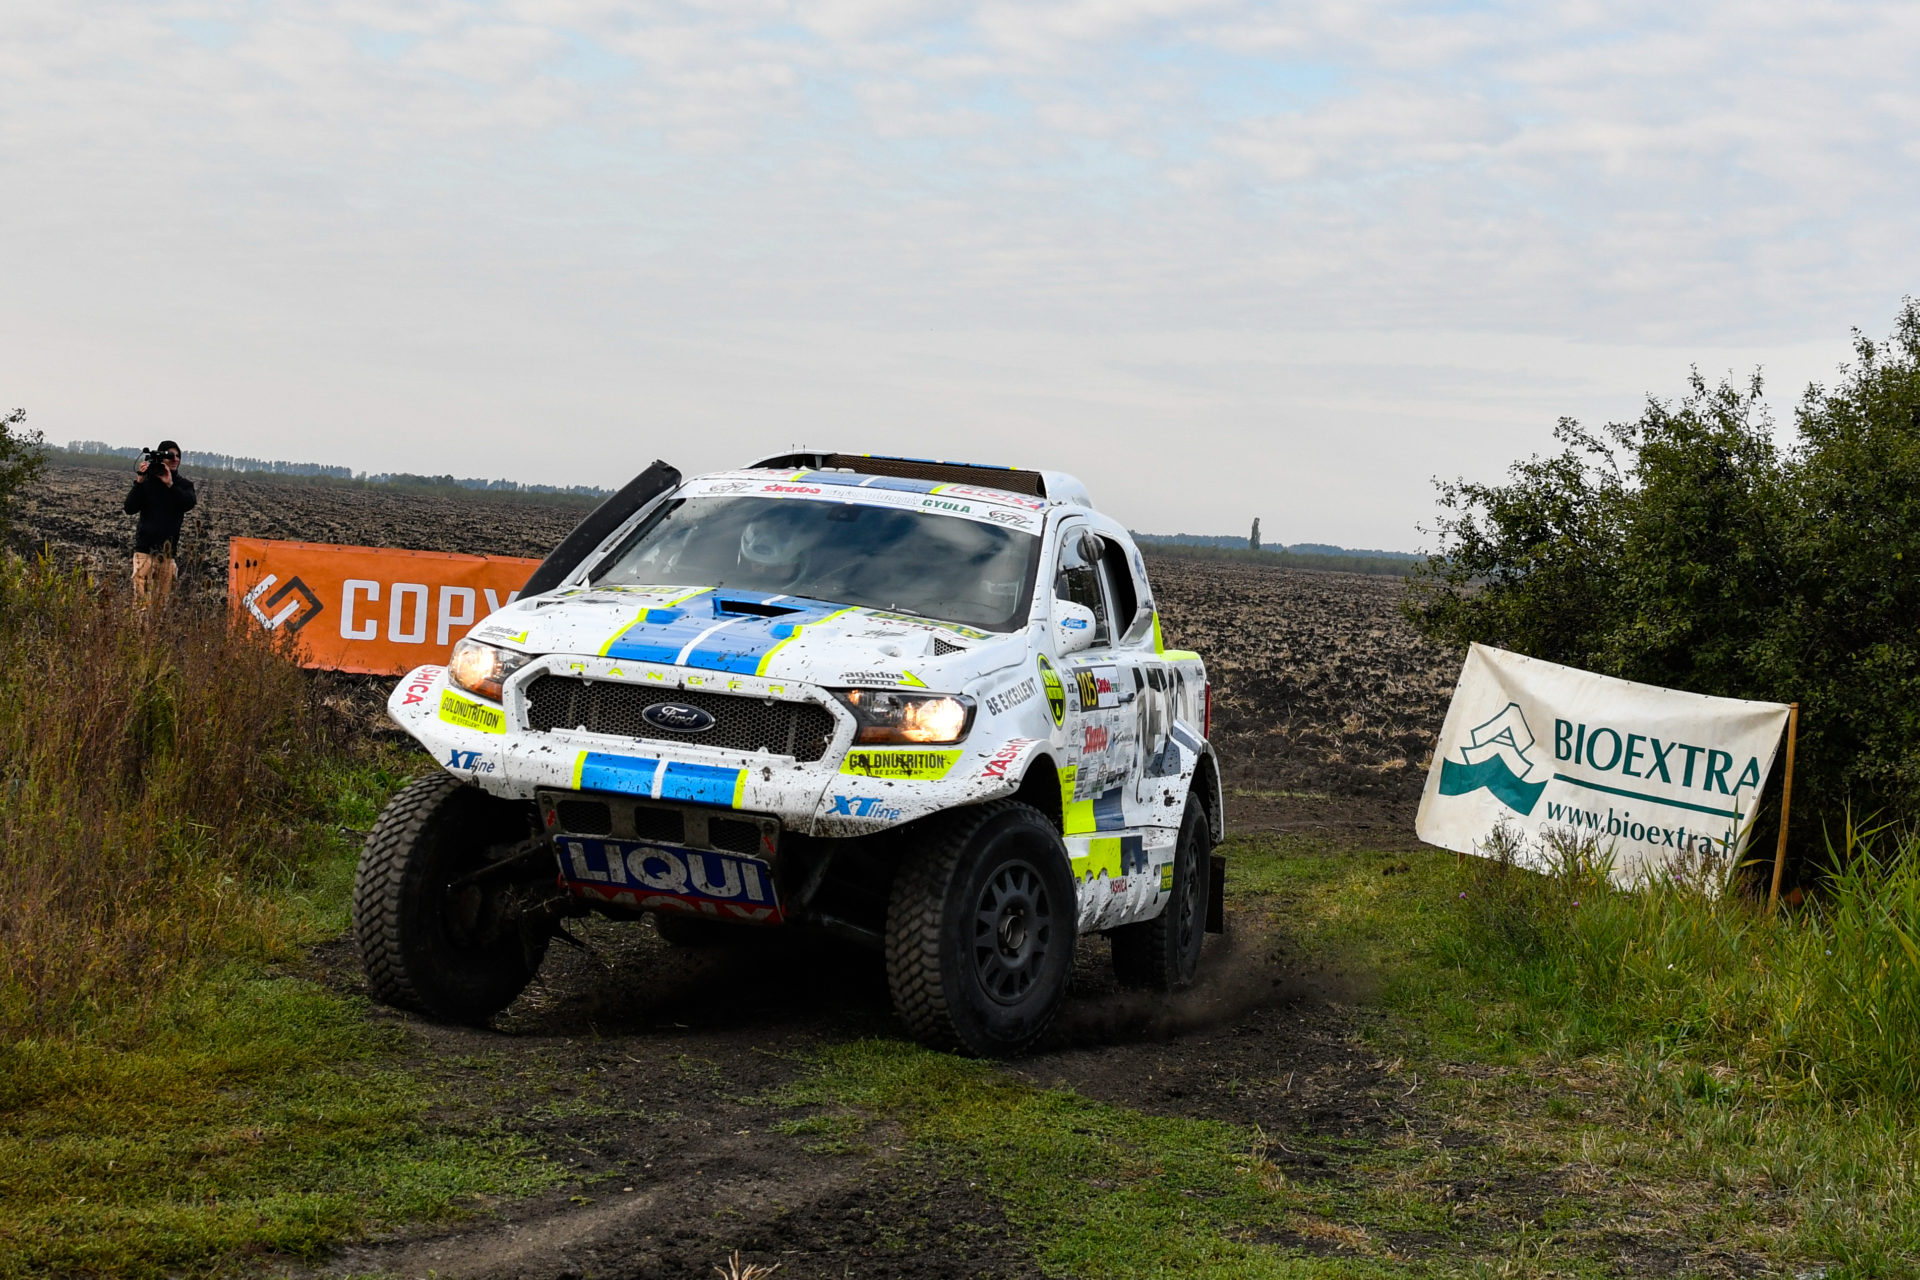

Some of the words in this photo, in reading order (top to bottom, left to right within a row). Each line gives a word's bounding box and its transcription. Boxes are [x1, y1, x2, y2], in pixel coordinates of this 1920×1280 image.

[922, 499, 971, 514] GYULA
[570, 663, 784, 694] RANGER
[845, 670, 904, 680] agados
[1076, 671, 1097, 707] 105
[985, 697, 1002, 716] BE
[997, 677, 1039, 710] EXCELLENT
[442, 697, 500, 729] GOLDNUTRITION
[657, 705, 698, 726] Ford
[849, 753, 944, 769] GOLDNUTRITION
[1555, 718, 1761, 797] BIOEXTRA
[825, 795, 901, 820] XTline
[568, 842, 764, 901] LIQUI
